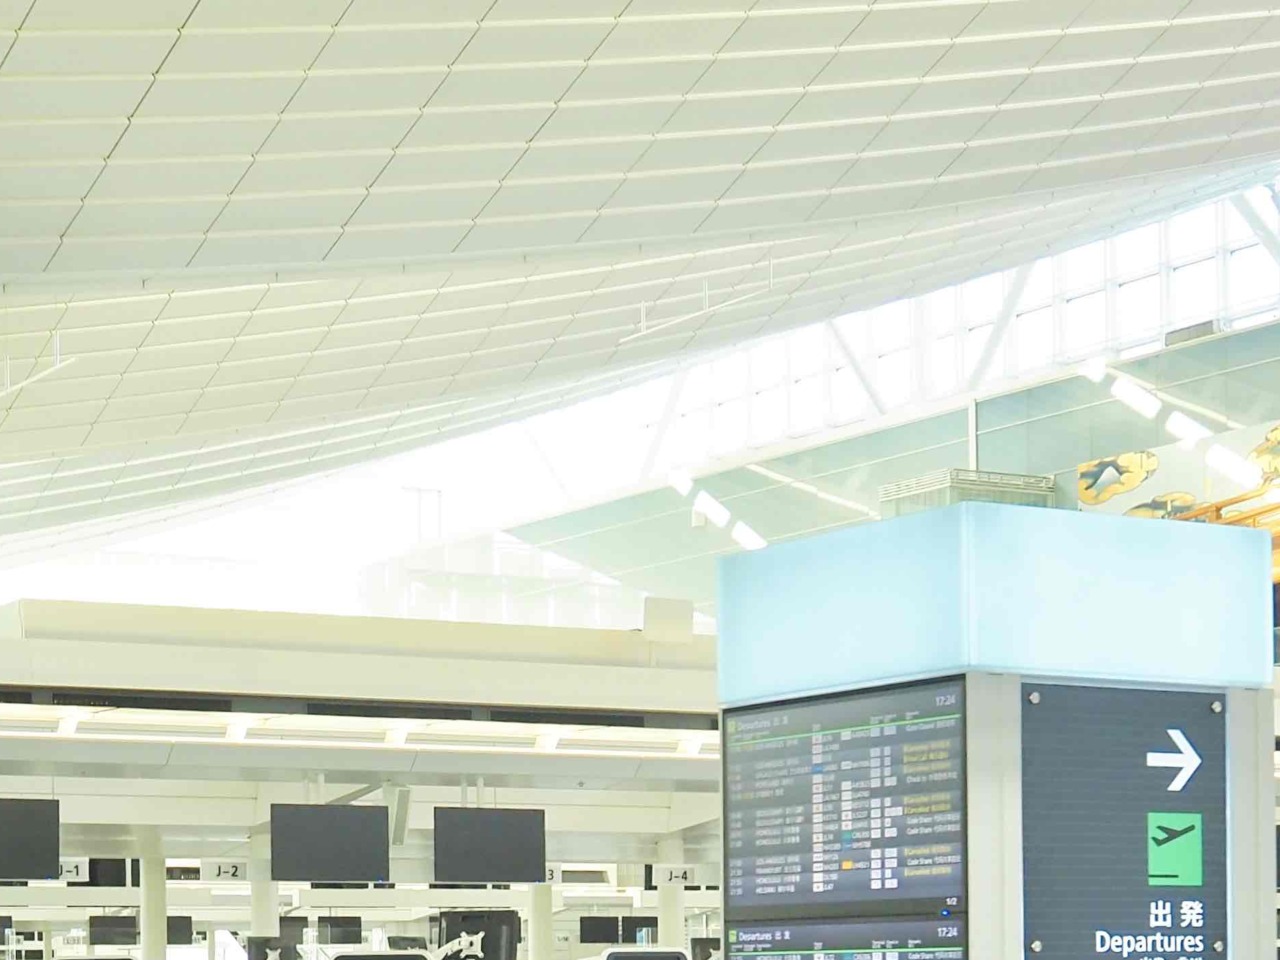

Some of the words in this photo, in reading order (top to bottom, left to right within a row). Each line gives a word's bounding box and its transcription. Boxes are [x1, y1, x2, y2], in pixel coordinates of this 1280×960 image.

[215, 865, 239, 878] J-2
[668, 870, 688, 882] J-4
[937, 927, 959, 938] 17:24
[1094, 930, 1205, 958] Departures
